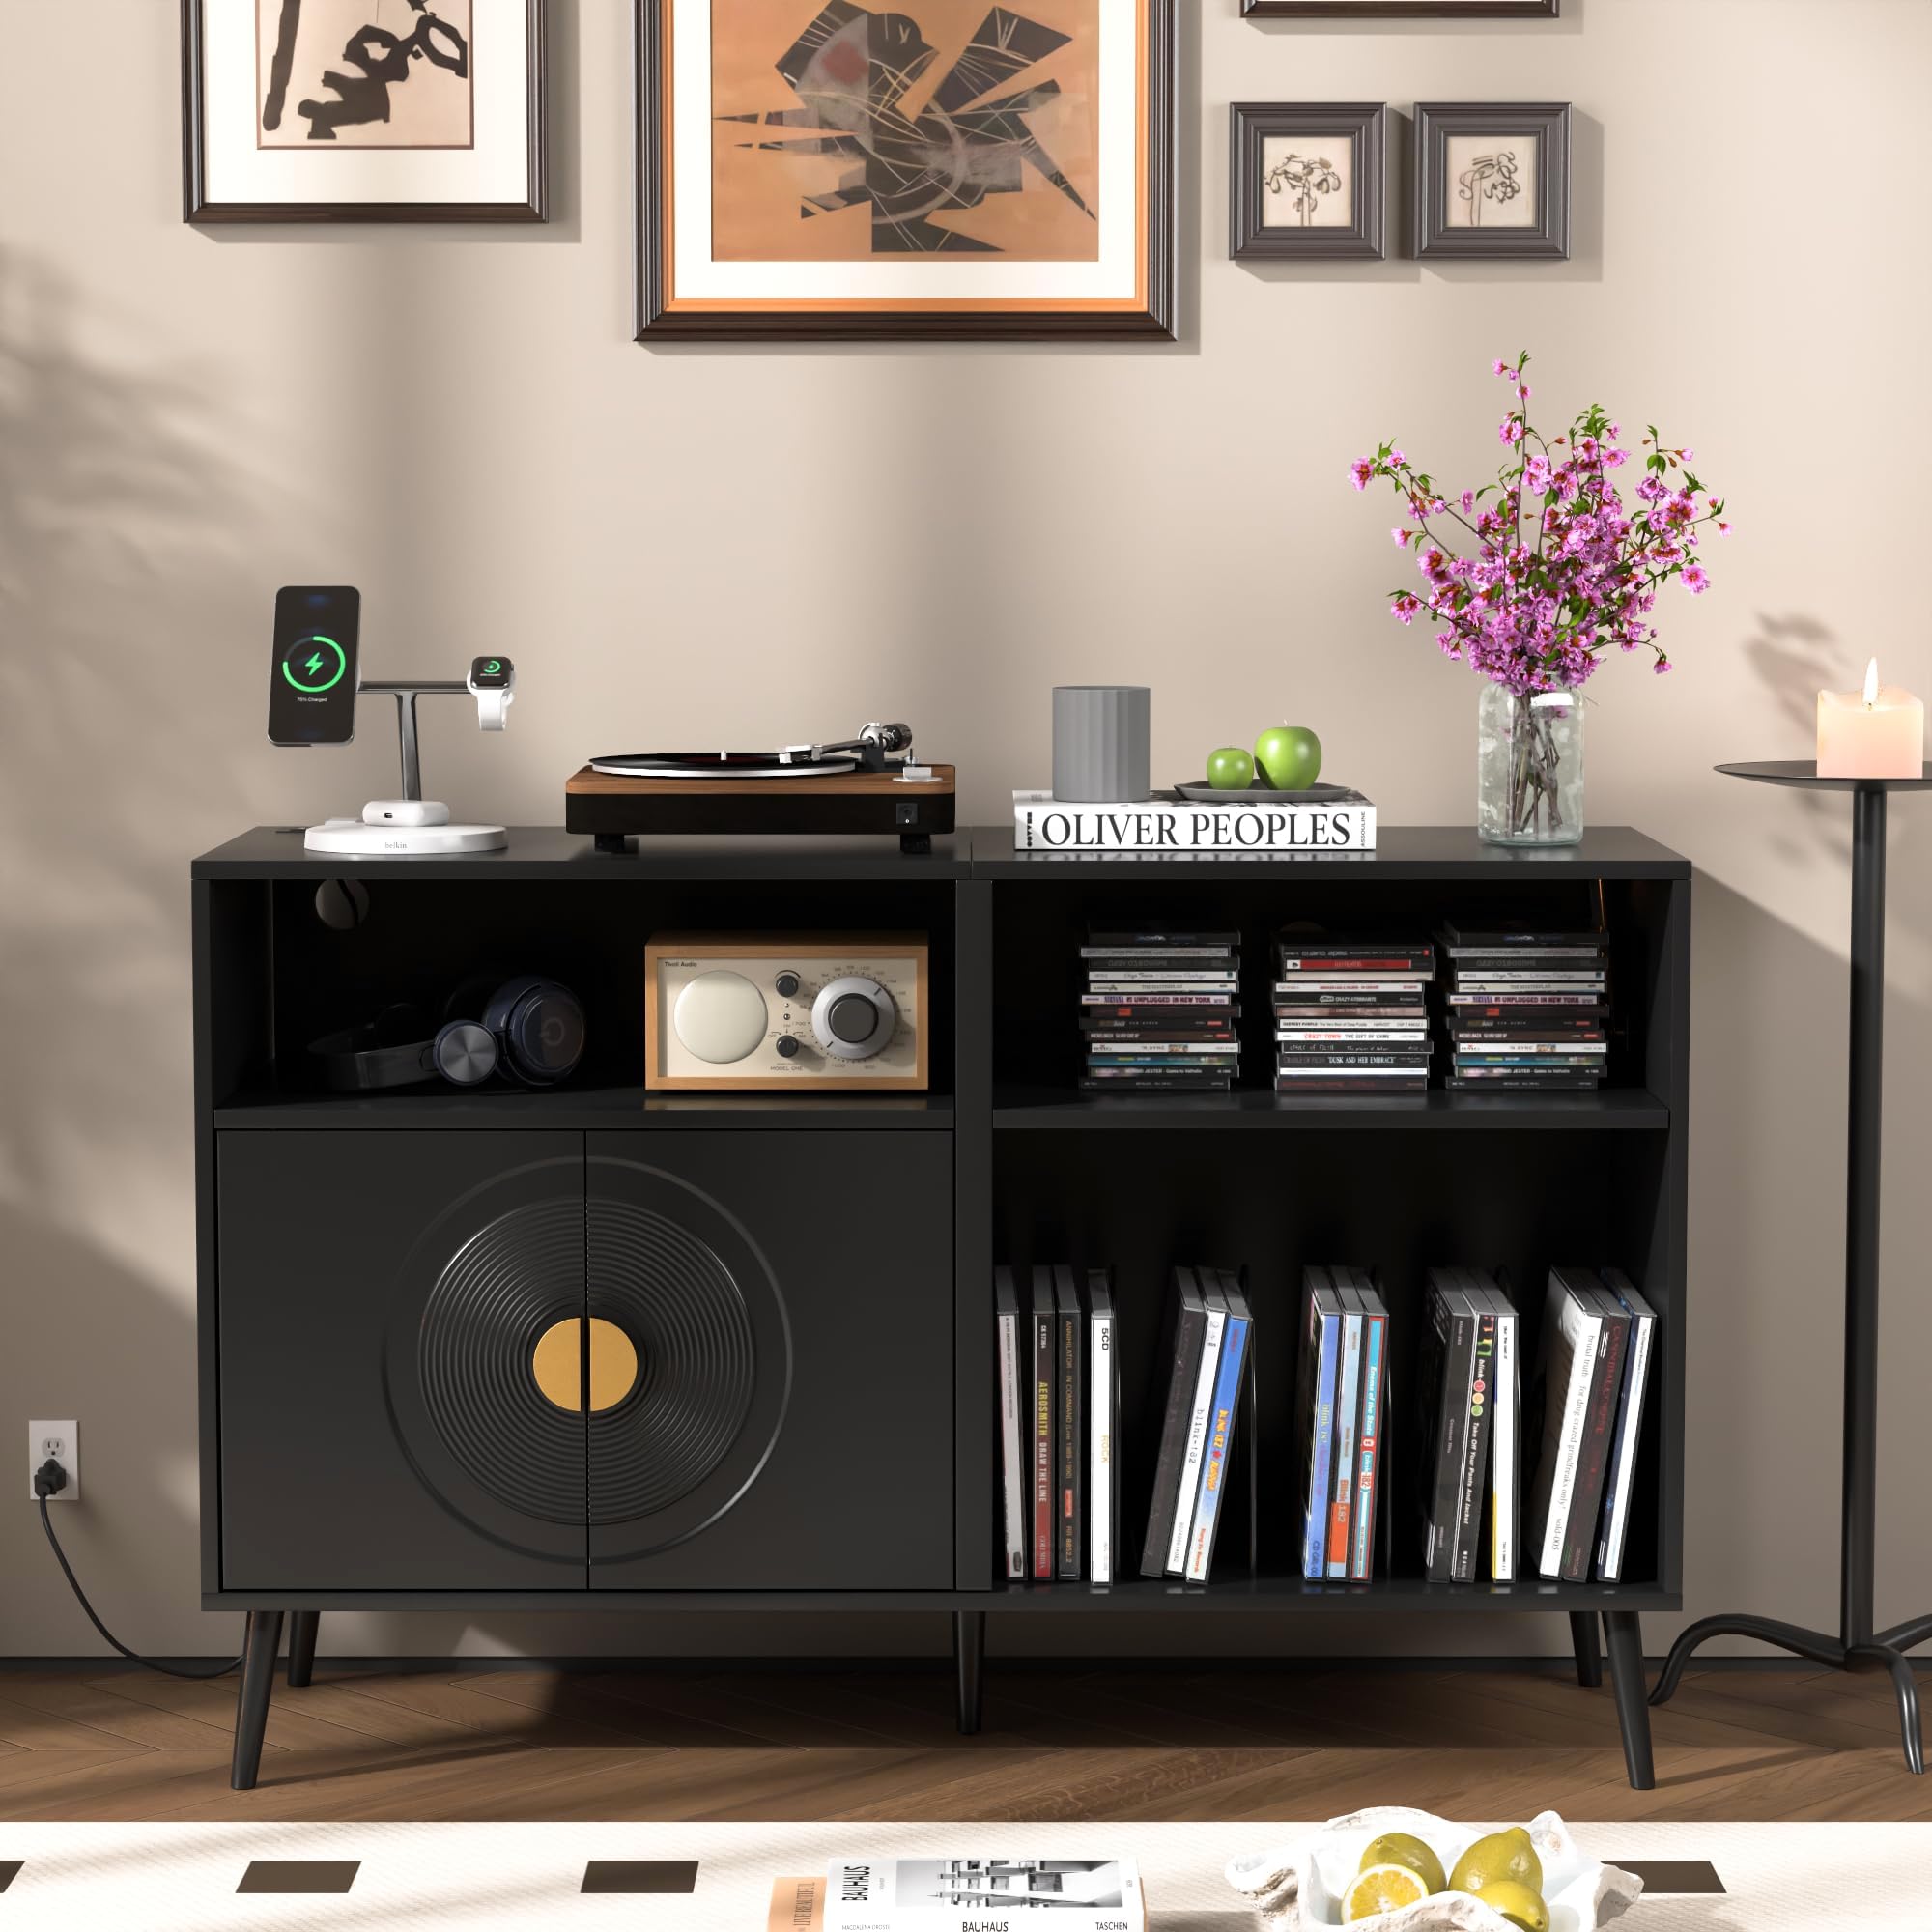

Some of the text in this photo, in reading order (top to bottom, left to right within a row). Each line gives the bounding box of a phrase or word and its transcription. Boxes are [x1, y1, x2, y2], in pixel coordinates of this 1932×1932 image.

[1042, 812, 1350, 846] OLIVER PEOPLES
[1101, 1326, 1110, 1350] 5CD
[1585, 1335, 1595, 1357] brutal
[1368, 1366, 1378, 1391] Enema
[1581, 1359, 1591, 1378] truth
[1038, 1381, 1048, 1435] AEROSMITH
[1321, 1404, 1330, 1427] blink
[1367, 1401, 1376, 1414] the
[1573, 1399, 1584, 1416] drug
[1216, 1409, 1229, 1432] BLINK
[1366, 1415, 1375, 1435] State
[1471, 1422, 1480, 1437] Take
[1188, 1408, 1205, 1463] blink-182
[1213, 1434, 1224, 1448] 182
[1569, 1419, 1579, 1444] crazed
[1038, 1442, 1047, 1465] DRAW
[1038, 1468, 1047, 1482] THE
[1562, 1444, 1575, 1488] grindfreaks
[1466, 1467, 1475, 1488] Pants
[1038, 1485, 1047, 1502] LINE
[1337, 1505, 1346, 1523] 182
[1065, 1525, 1073, 1536] RR
[1551, 1518, 1562, 1551] sold-005
[1312, 1540, 1320, 1550] CD
[841, 1865, 871, 1901] BAUHAUS
[793, 1882, 815, 1926] LIVE BEAUTIFUL
[962, 1921, 1009, 1932] BAUHAUS
[1095, 1921, 1128, 1931] TASCHEN
